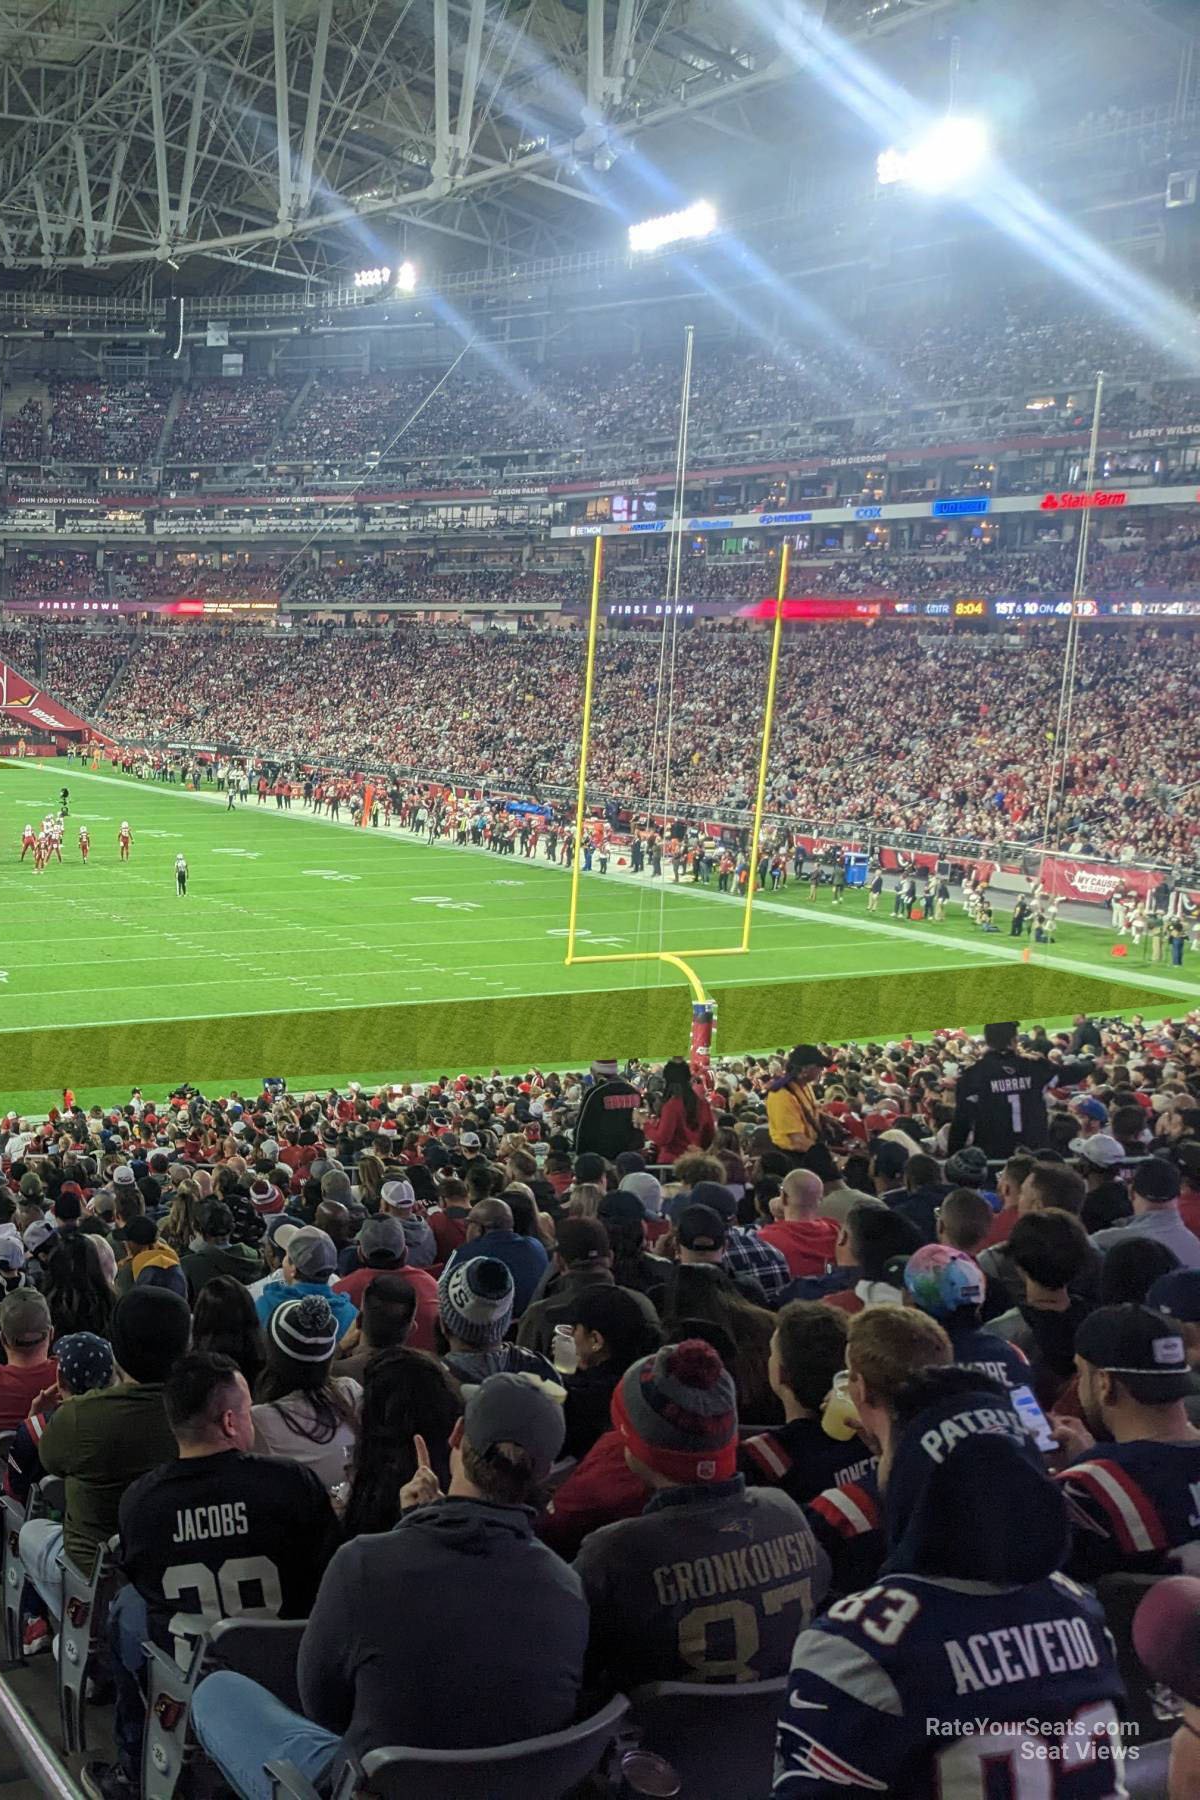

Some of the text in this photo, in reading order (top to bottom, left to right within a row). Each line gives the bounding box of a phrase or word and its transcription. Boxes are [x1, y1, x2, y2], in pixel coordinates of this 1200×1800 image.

[1129, 425, 1200, 439] LARRY WILSO
[855, 506, 882, 520] COX
[39, 602, 77, 610] FIRST
[611, 605, 694, 614] FIRST DOWN
[955, 602, 983, 615] 8:04
[995, 603, 1015, 614] 1ST
[1024, 603, 1038, 614] 10
[1039, 605, 1053, 613] ON
[1055, 603, 1072, 614] 40
[28, 708, 67, 729] verizon
[1091, 878, 1118, 887] CAUSE
[546, 928, 634, 949] 10
[990, 1076, 1031, 1093] MURRAY
[1007, 1094, 1022, 1133] 1
[920, 1408, 1022, 1464] PATRI
[173, 1502, 248, 1543] JACOBS
[828, 1584, 920, 1645] 83
[678, 1577, 814, 1684] 87
[944, 1617, 1099, 1696] ACEVEDO
